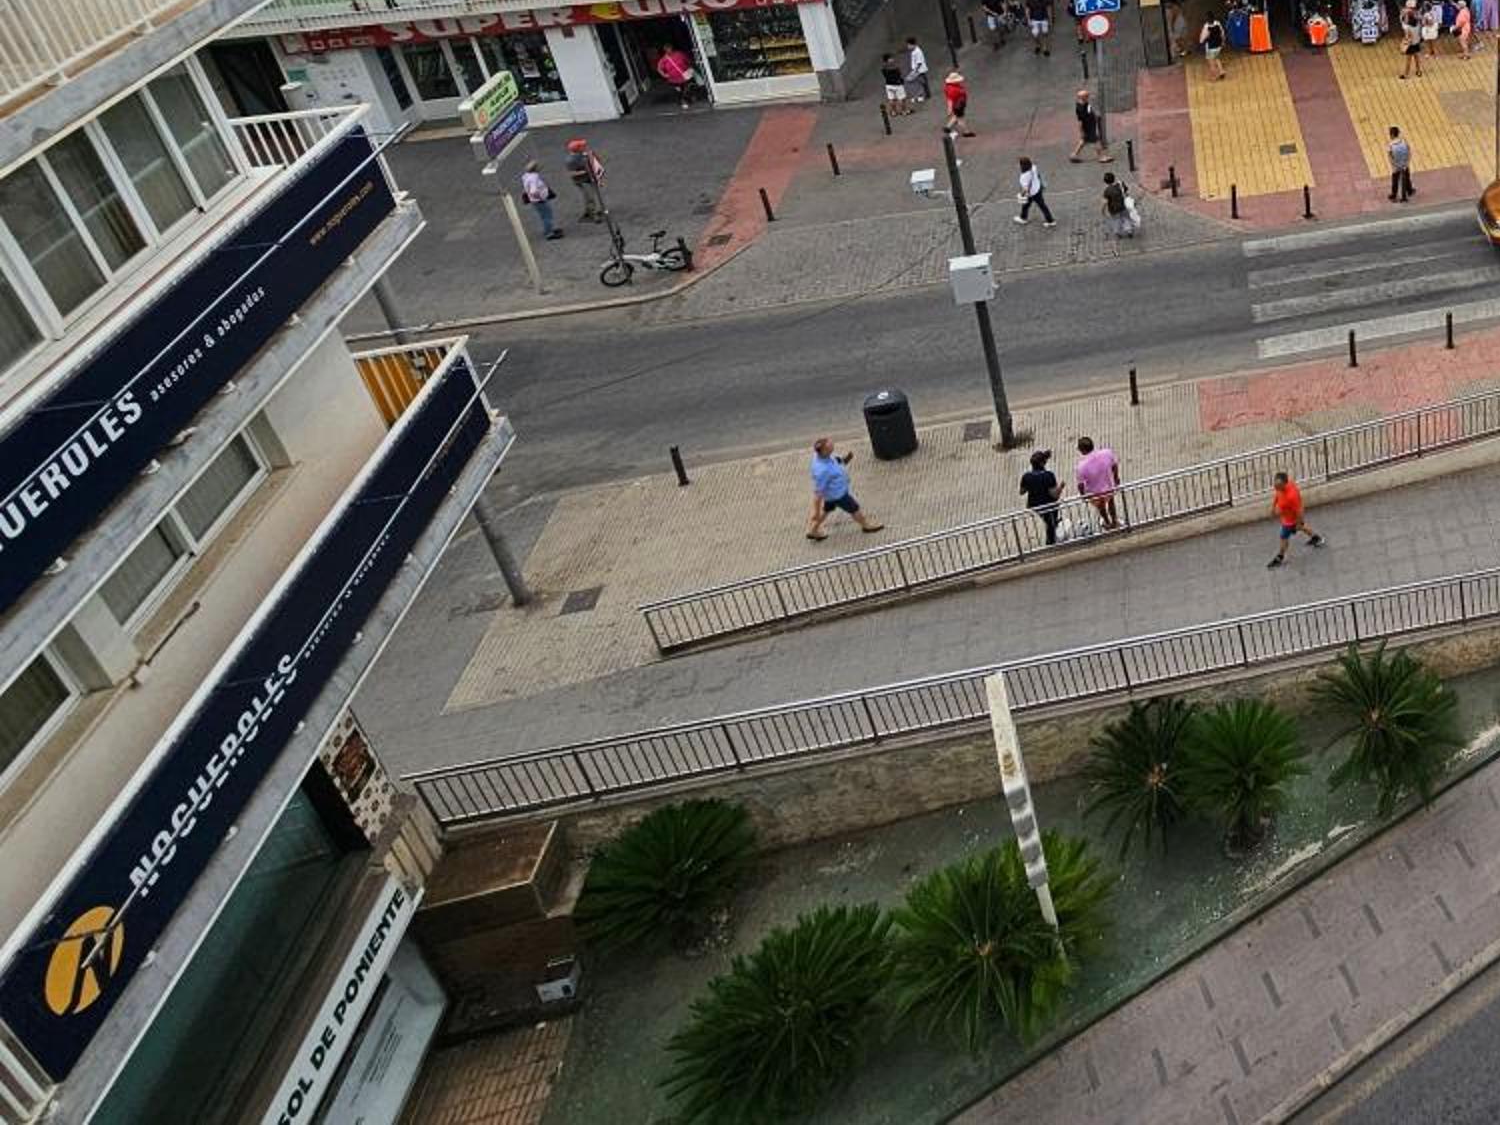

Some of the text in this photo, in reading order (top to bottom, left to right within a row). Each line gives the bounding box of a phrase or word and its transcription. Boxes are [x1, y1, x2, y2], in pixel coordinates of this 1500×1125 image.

[382, 6, 574, 42] SUPER
[0, 286, 265, 551] UEROLES asesores & abogados
[129, 654, 300, 897] NOGUEROLES
[309, 1025, 337, 1072] DE
[333, 888, 405, 1027] PONIENTE
